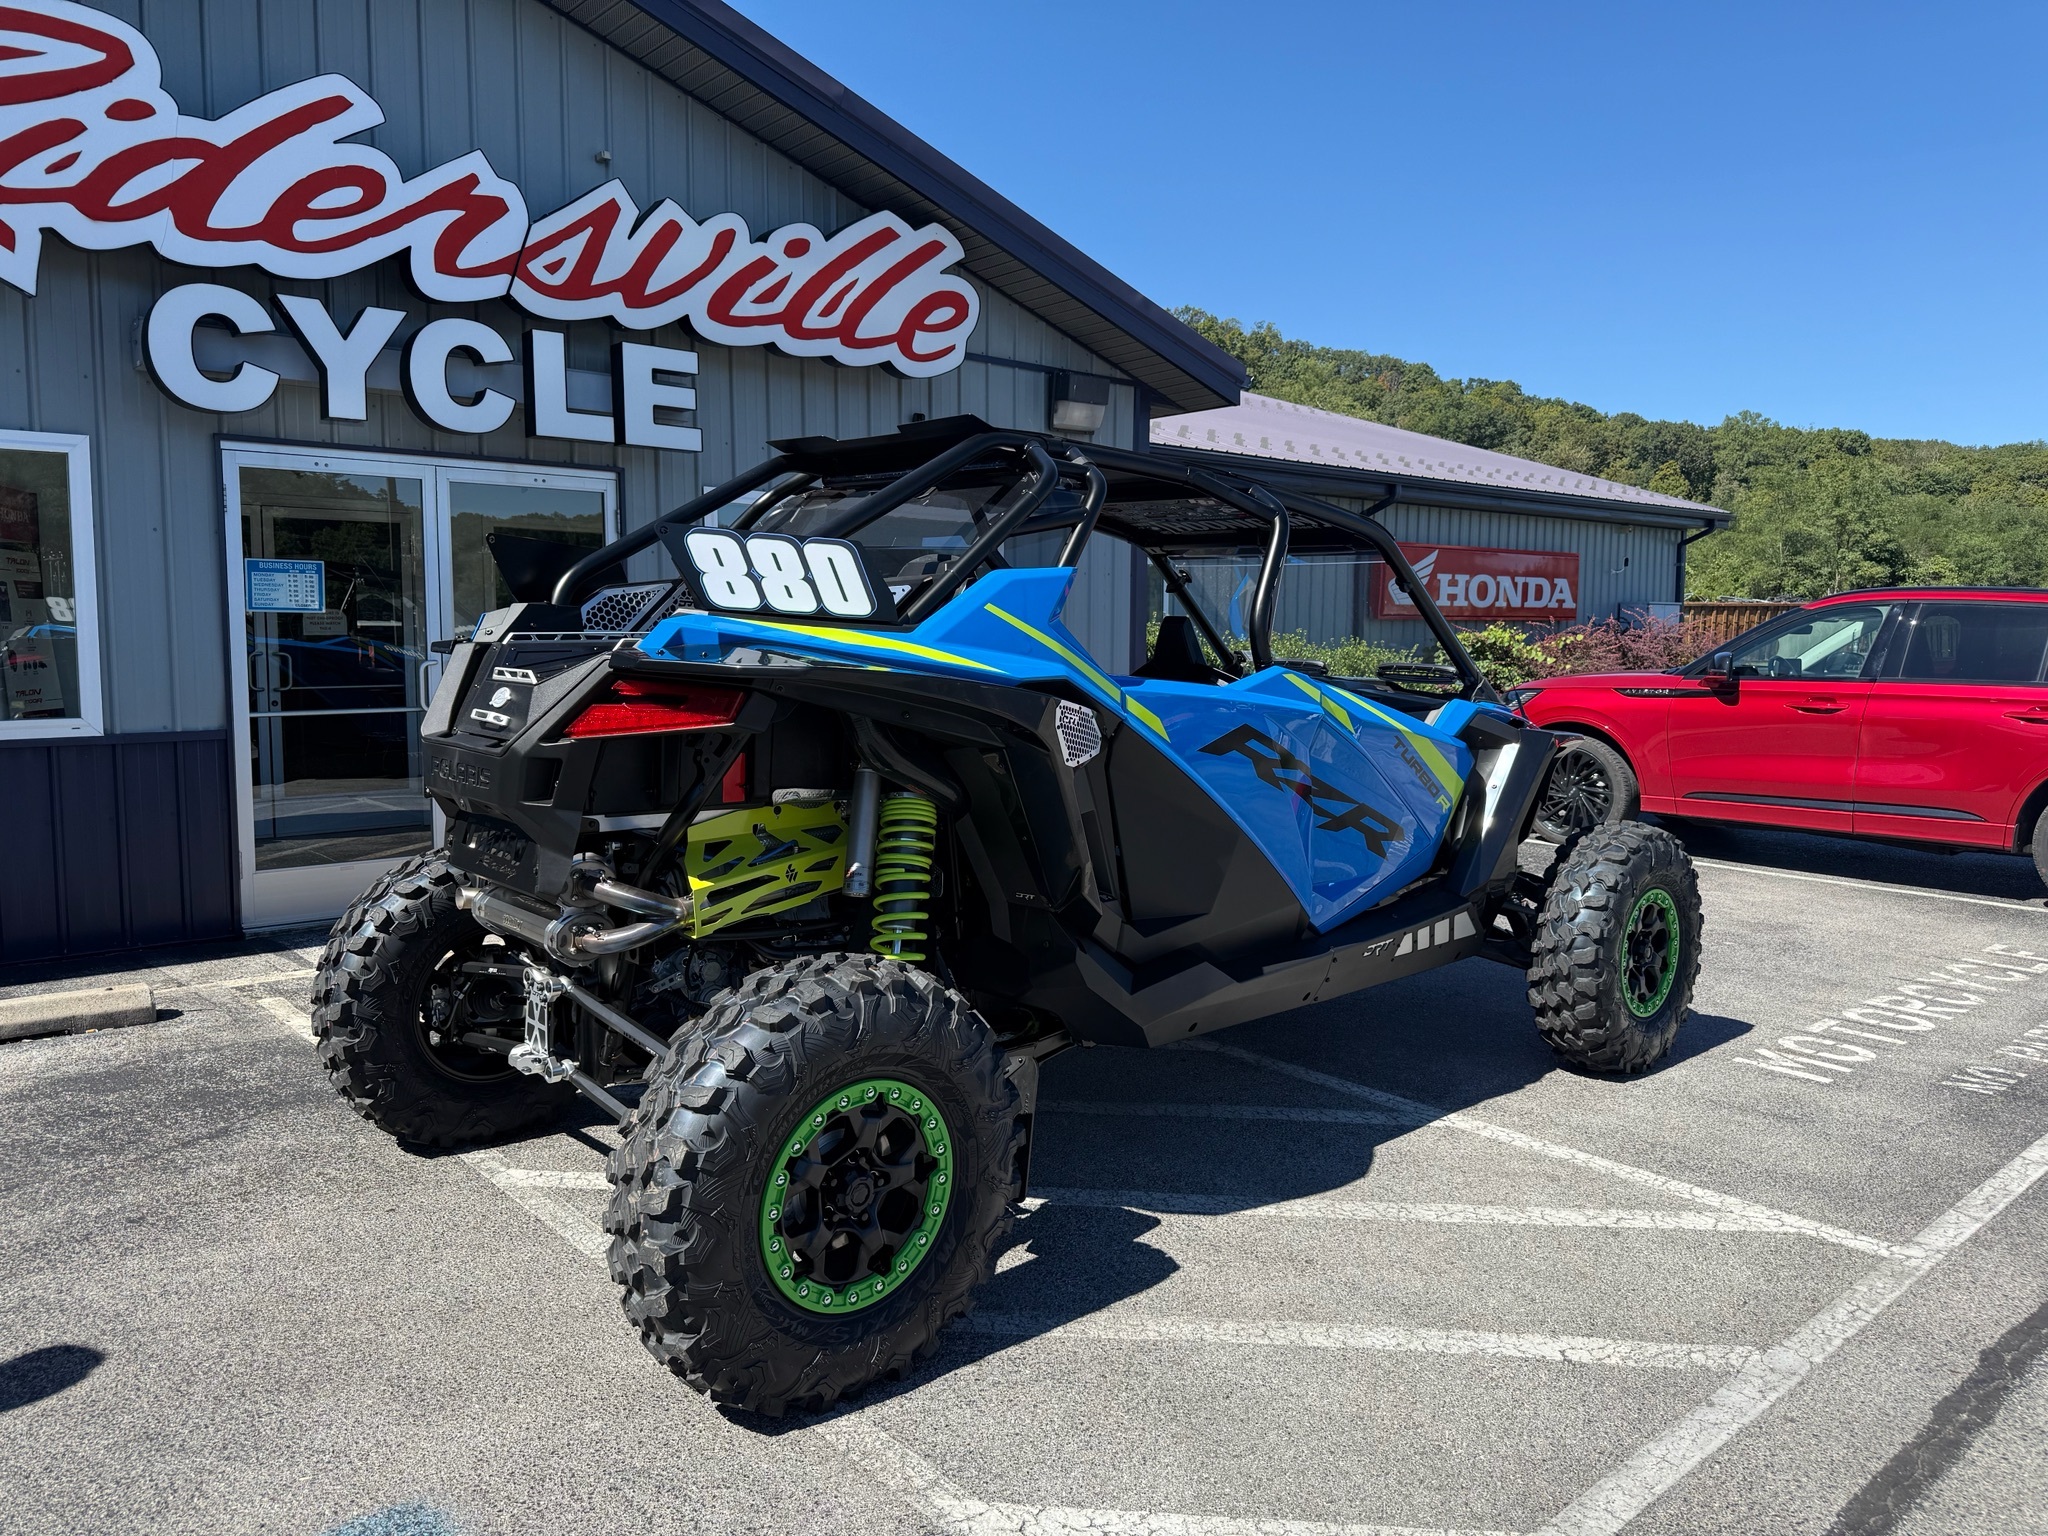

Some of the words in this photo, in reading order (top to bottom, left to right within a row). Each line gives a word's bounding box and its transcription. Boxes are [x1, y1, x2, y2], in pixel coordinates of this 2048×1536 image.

[146, 282, 703, 453] CYCLE
[259, 561, 293, 569] BUSINESS
[685, 529, 876, 618] 880
[1436, 573, 1576, 609] HONDA
[431, 756, 491, 790] POLARIS
[1197, 723, 1406, 862] RZR
[1394, 735, 1441, 798] TURBO
[1436, 794, 1451, 814] R
